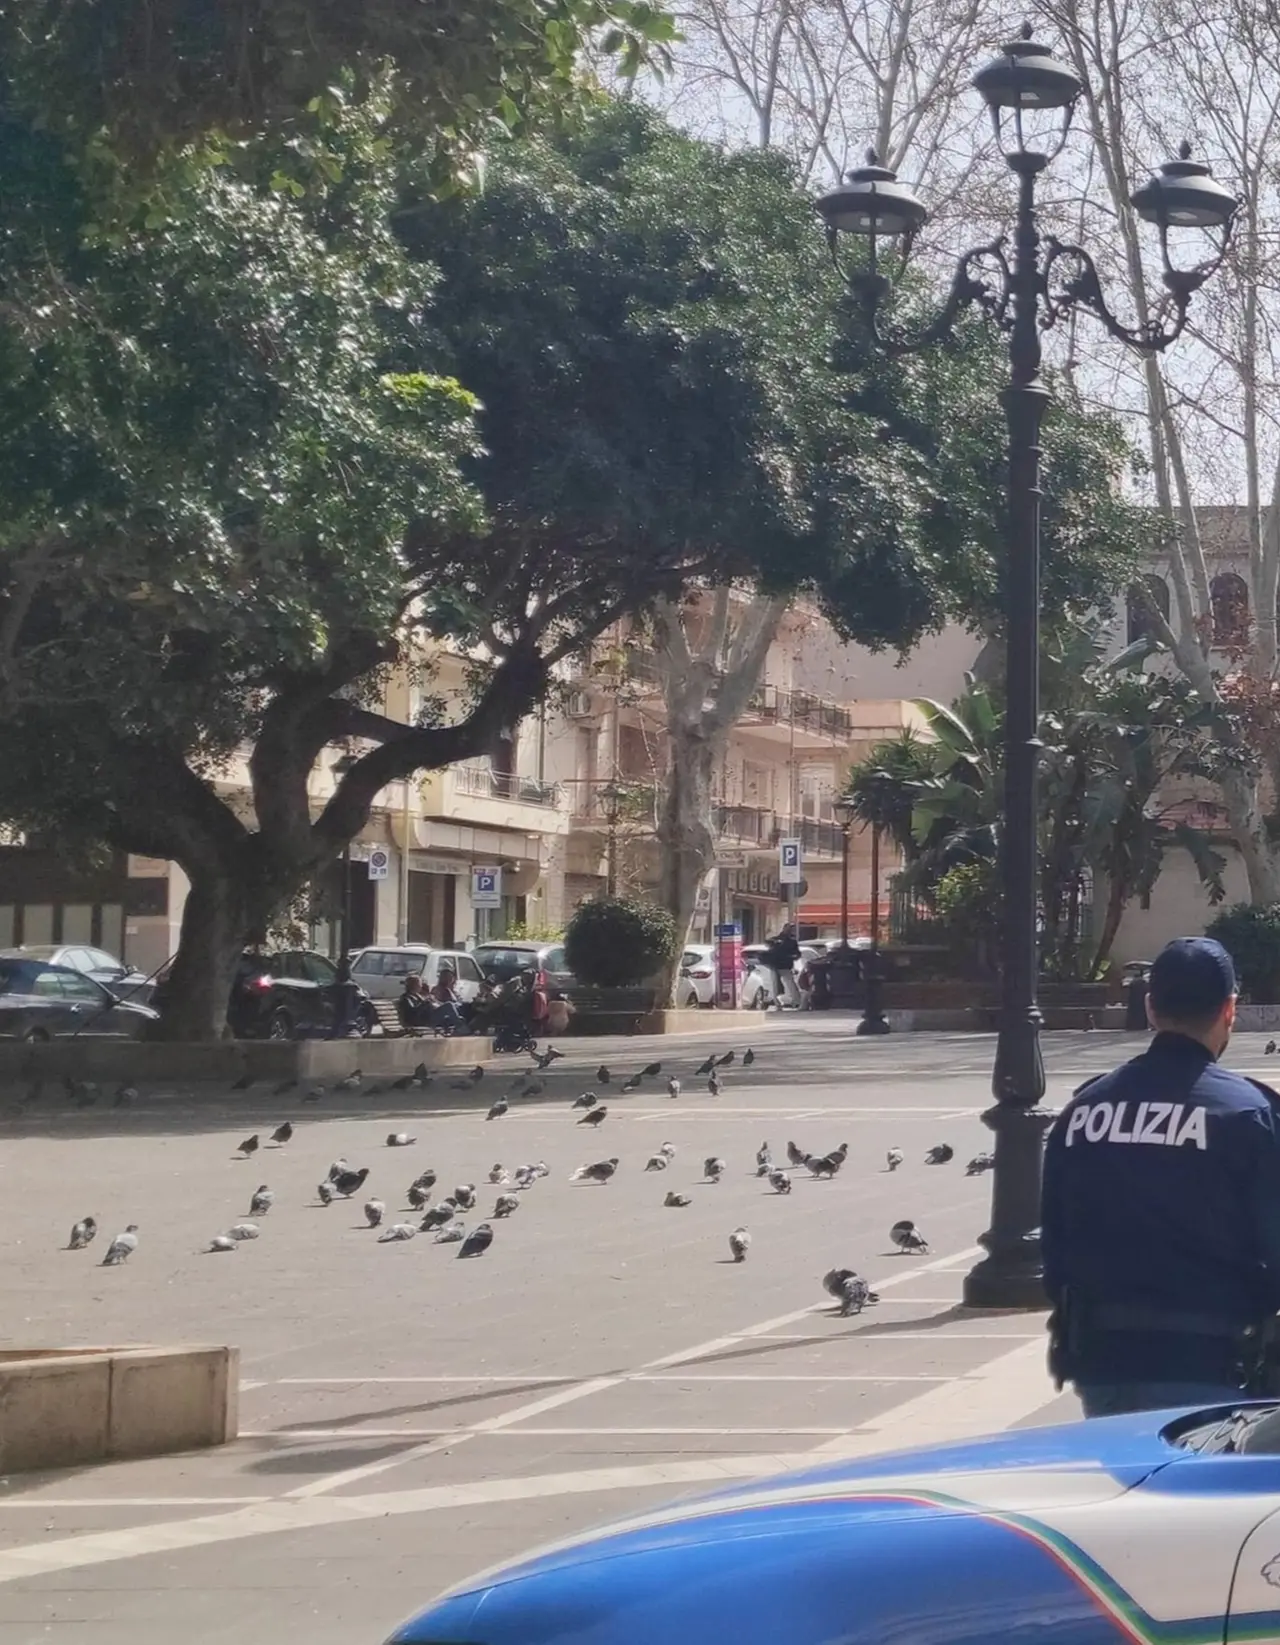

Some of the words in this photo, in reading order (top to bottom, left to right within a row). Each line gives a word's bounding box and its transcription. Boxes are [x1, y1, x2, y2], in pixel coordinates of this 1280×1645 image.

[785, 847, 795, 864] P
[480, 876, 491, 889] P
[1065, 1101, 1207, 1150] POLIZIA
